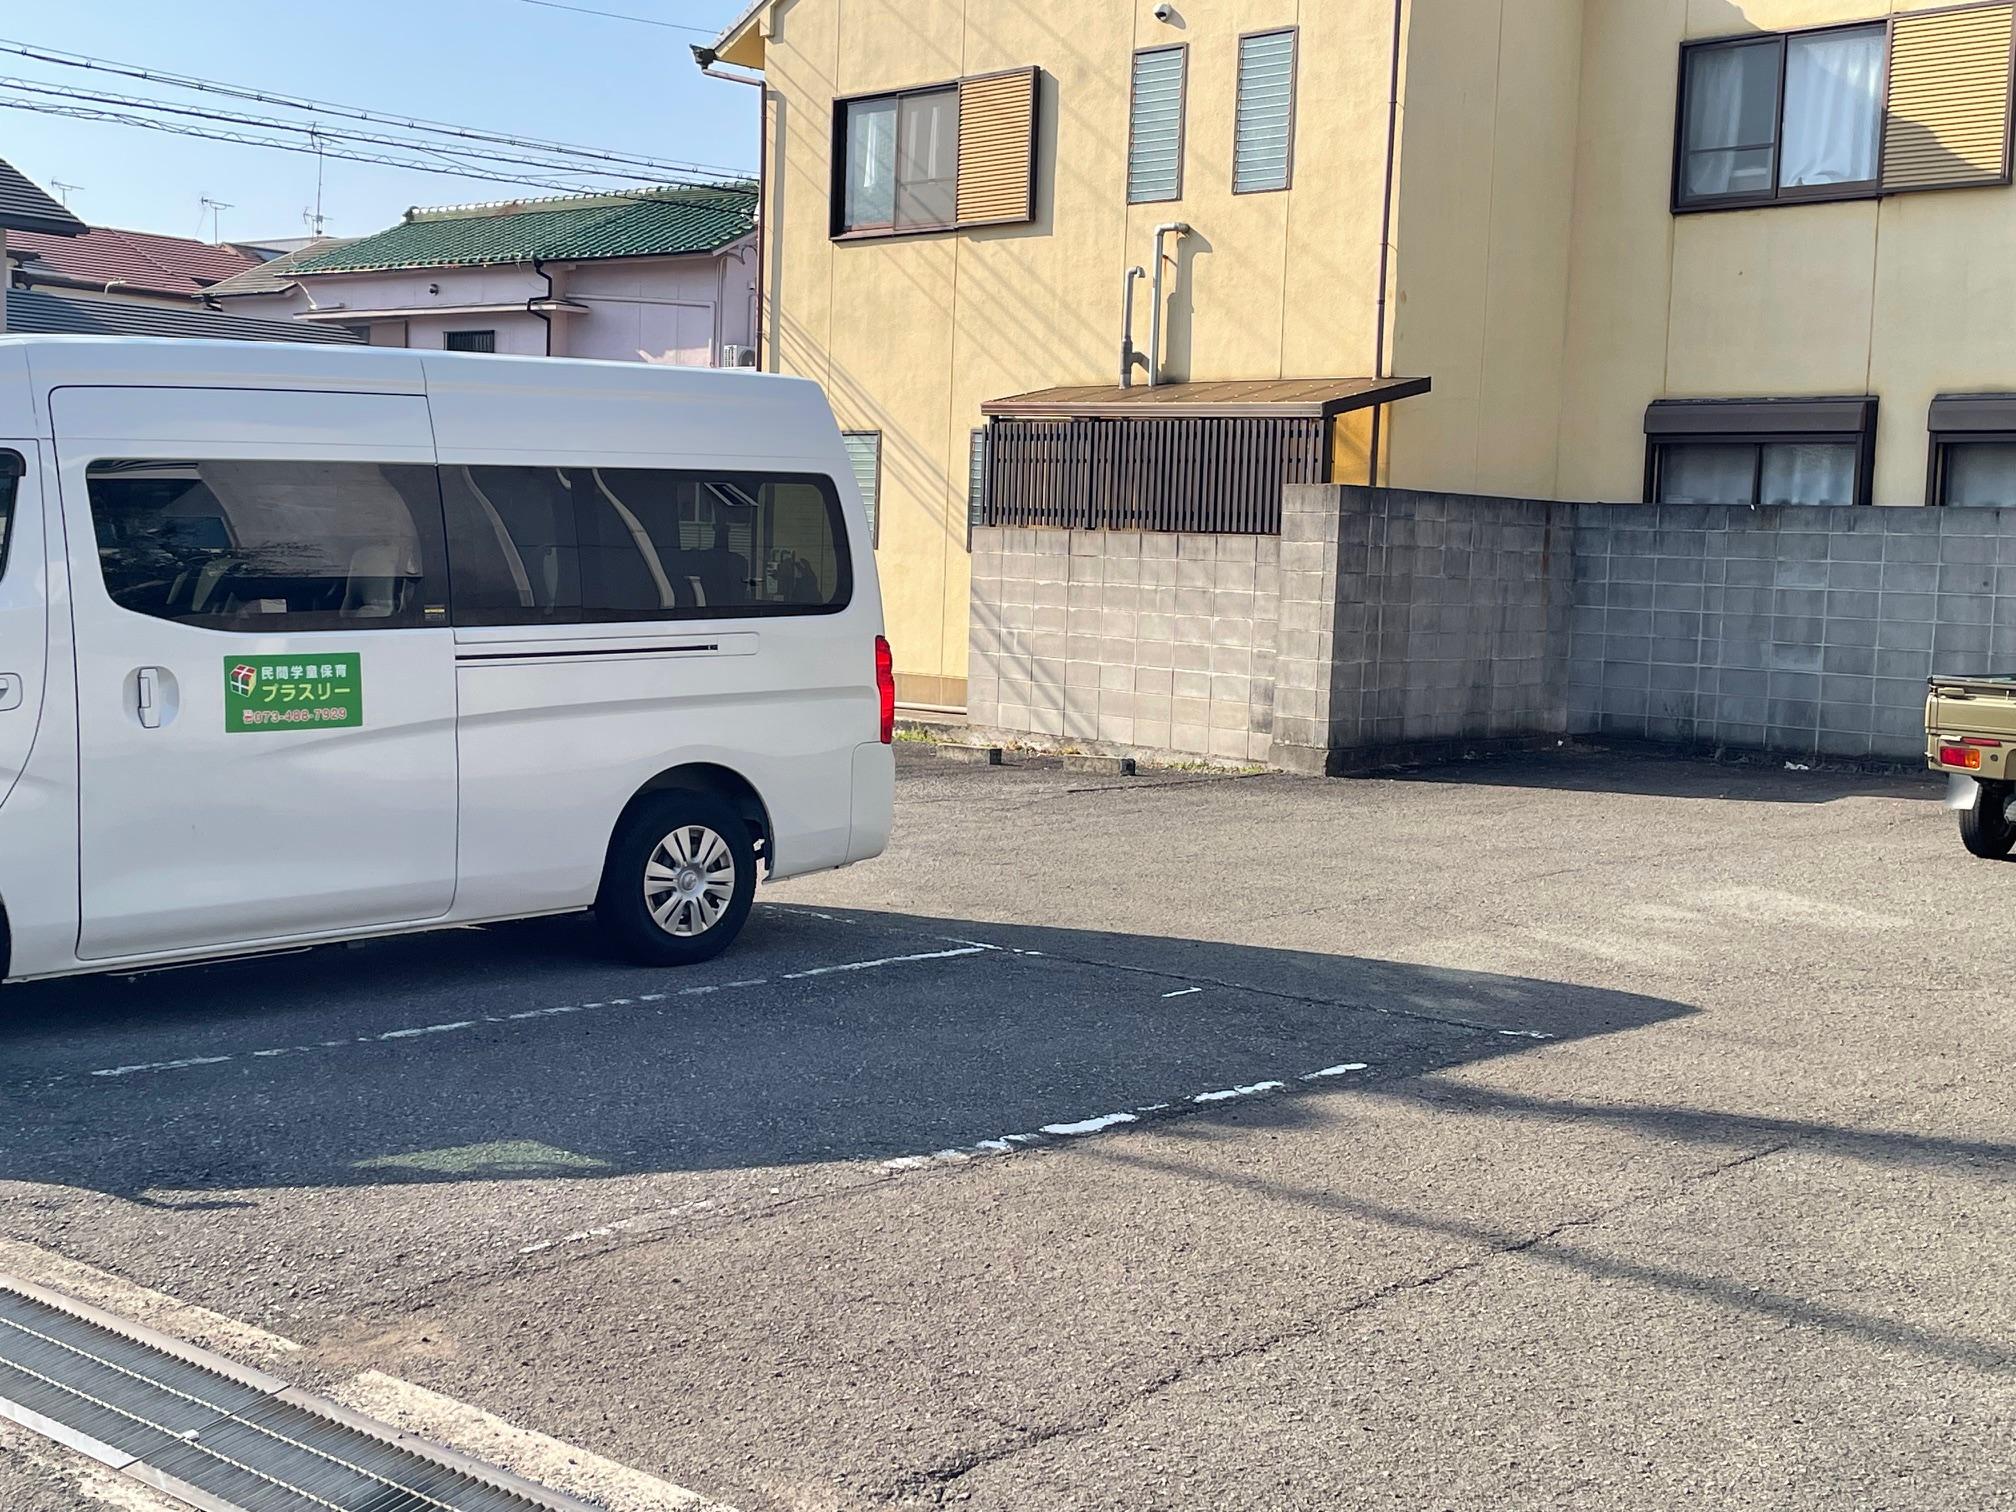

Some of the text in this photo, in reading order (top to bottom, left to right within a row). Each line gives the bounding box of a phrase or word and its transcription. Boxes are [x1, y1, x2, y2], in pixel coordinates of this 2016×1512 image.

[261, 664, 347, 680] 民間学童保育
